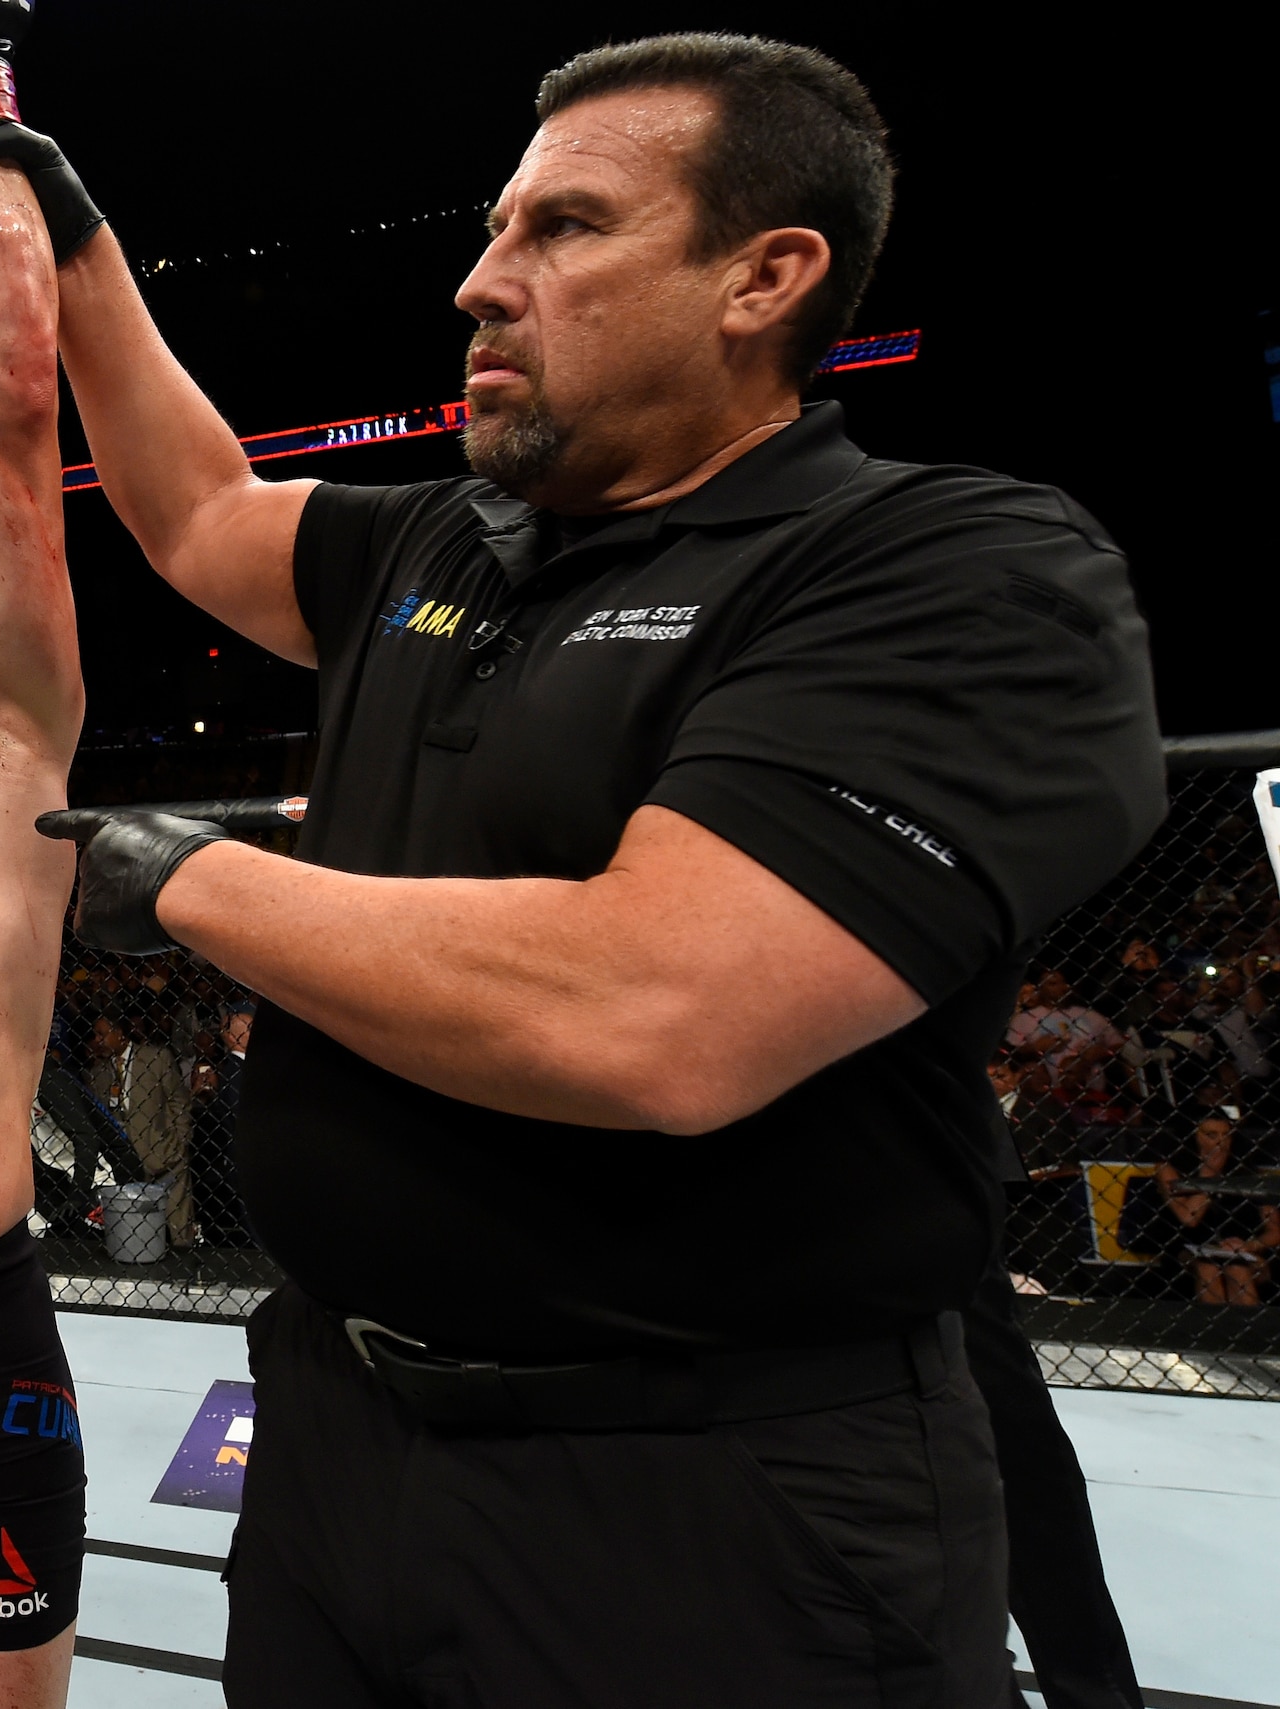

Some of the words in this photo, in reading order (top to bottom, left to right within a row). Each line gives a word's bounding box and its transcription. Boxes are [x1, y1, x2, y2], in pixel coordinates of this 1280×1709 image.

[326, 416, 408, 446] PATRICK
[406, 599, 466, 639] MMA
[650, 605, 702, 622] STATE
